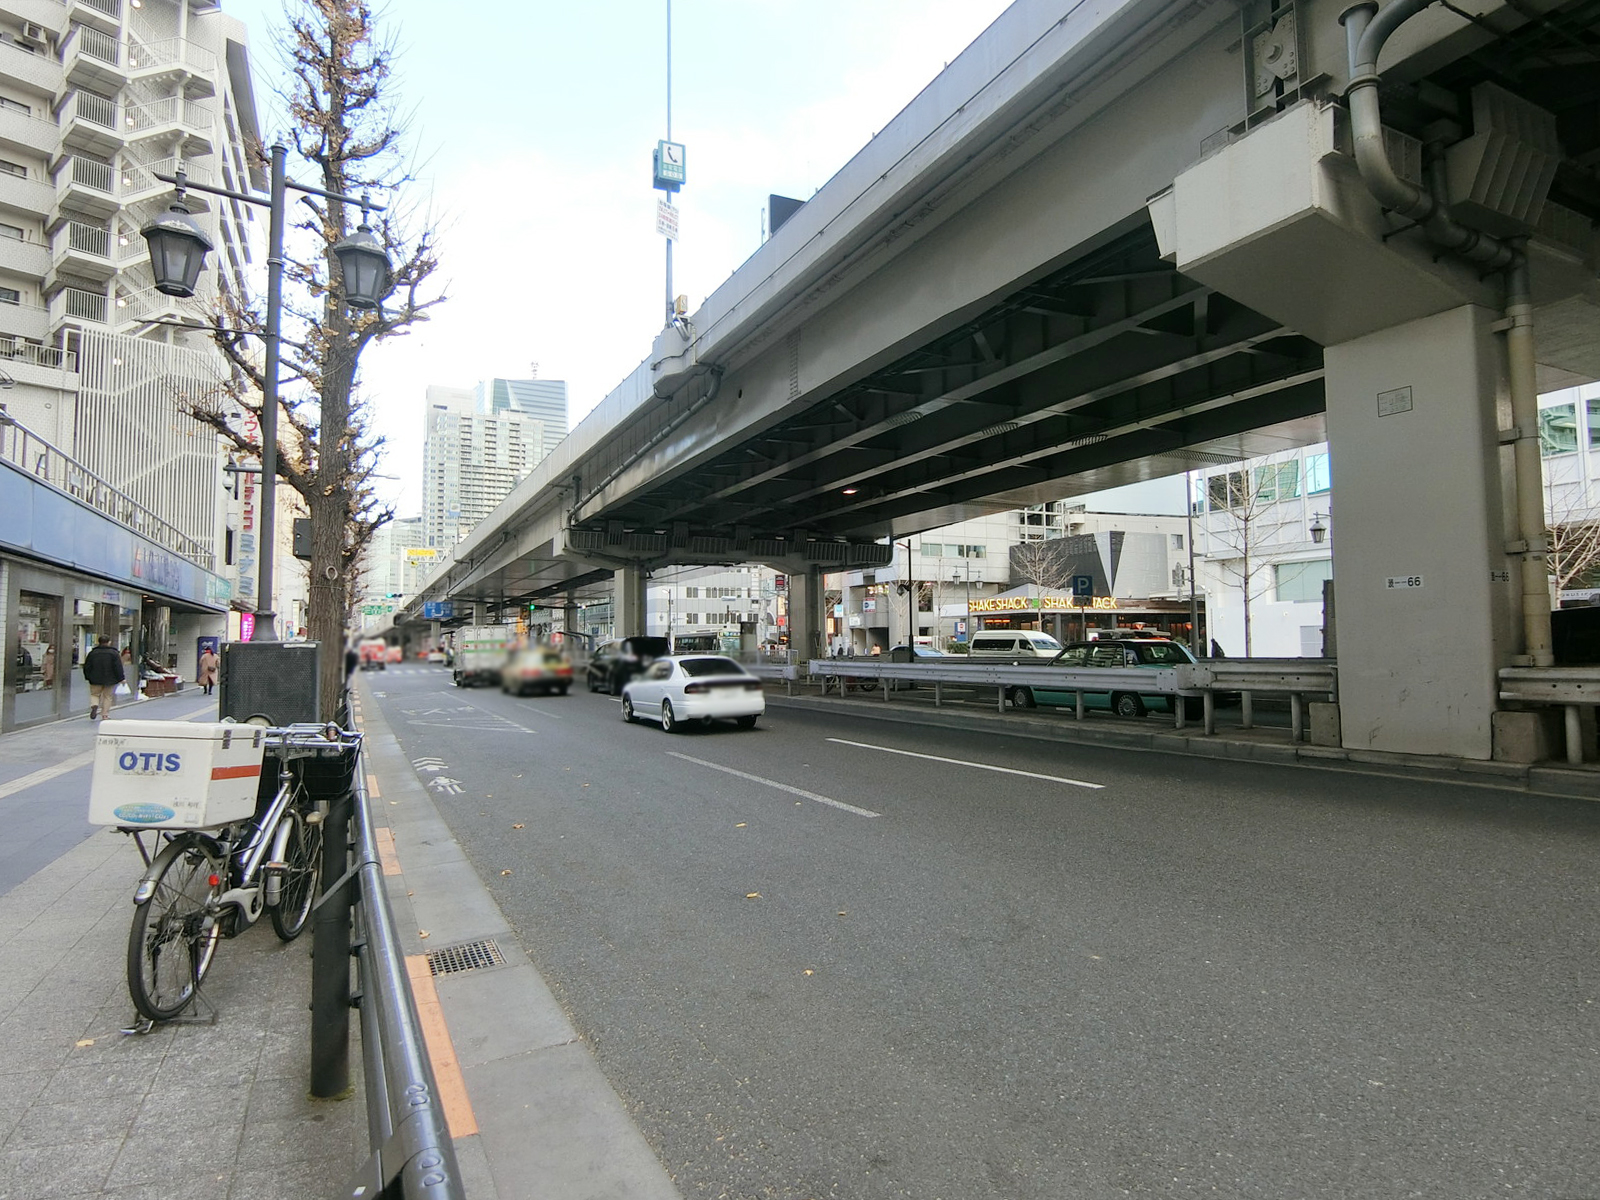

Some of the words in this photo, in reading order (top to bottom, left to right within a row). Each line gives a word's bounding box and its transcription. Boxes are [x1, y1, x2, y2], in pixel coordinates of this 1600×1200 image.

[1078, 577, 1089, 594] P
[968, 598, 996, 612] SHAKE
[996, 595, 1028, 610] SHACK
[1044, 595, 1079, 609] SHAK
[119, 751, 182, 772] OTIS
